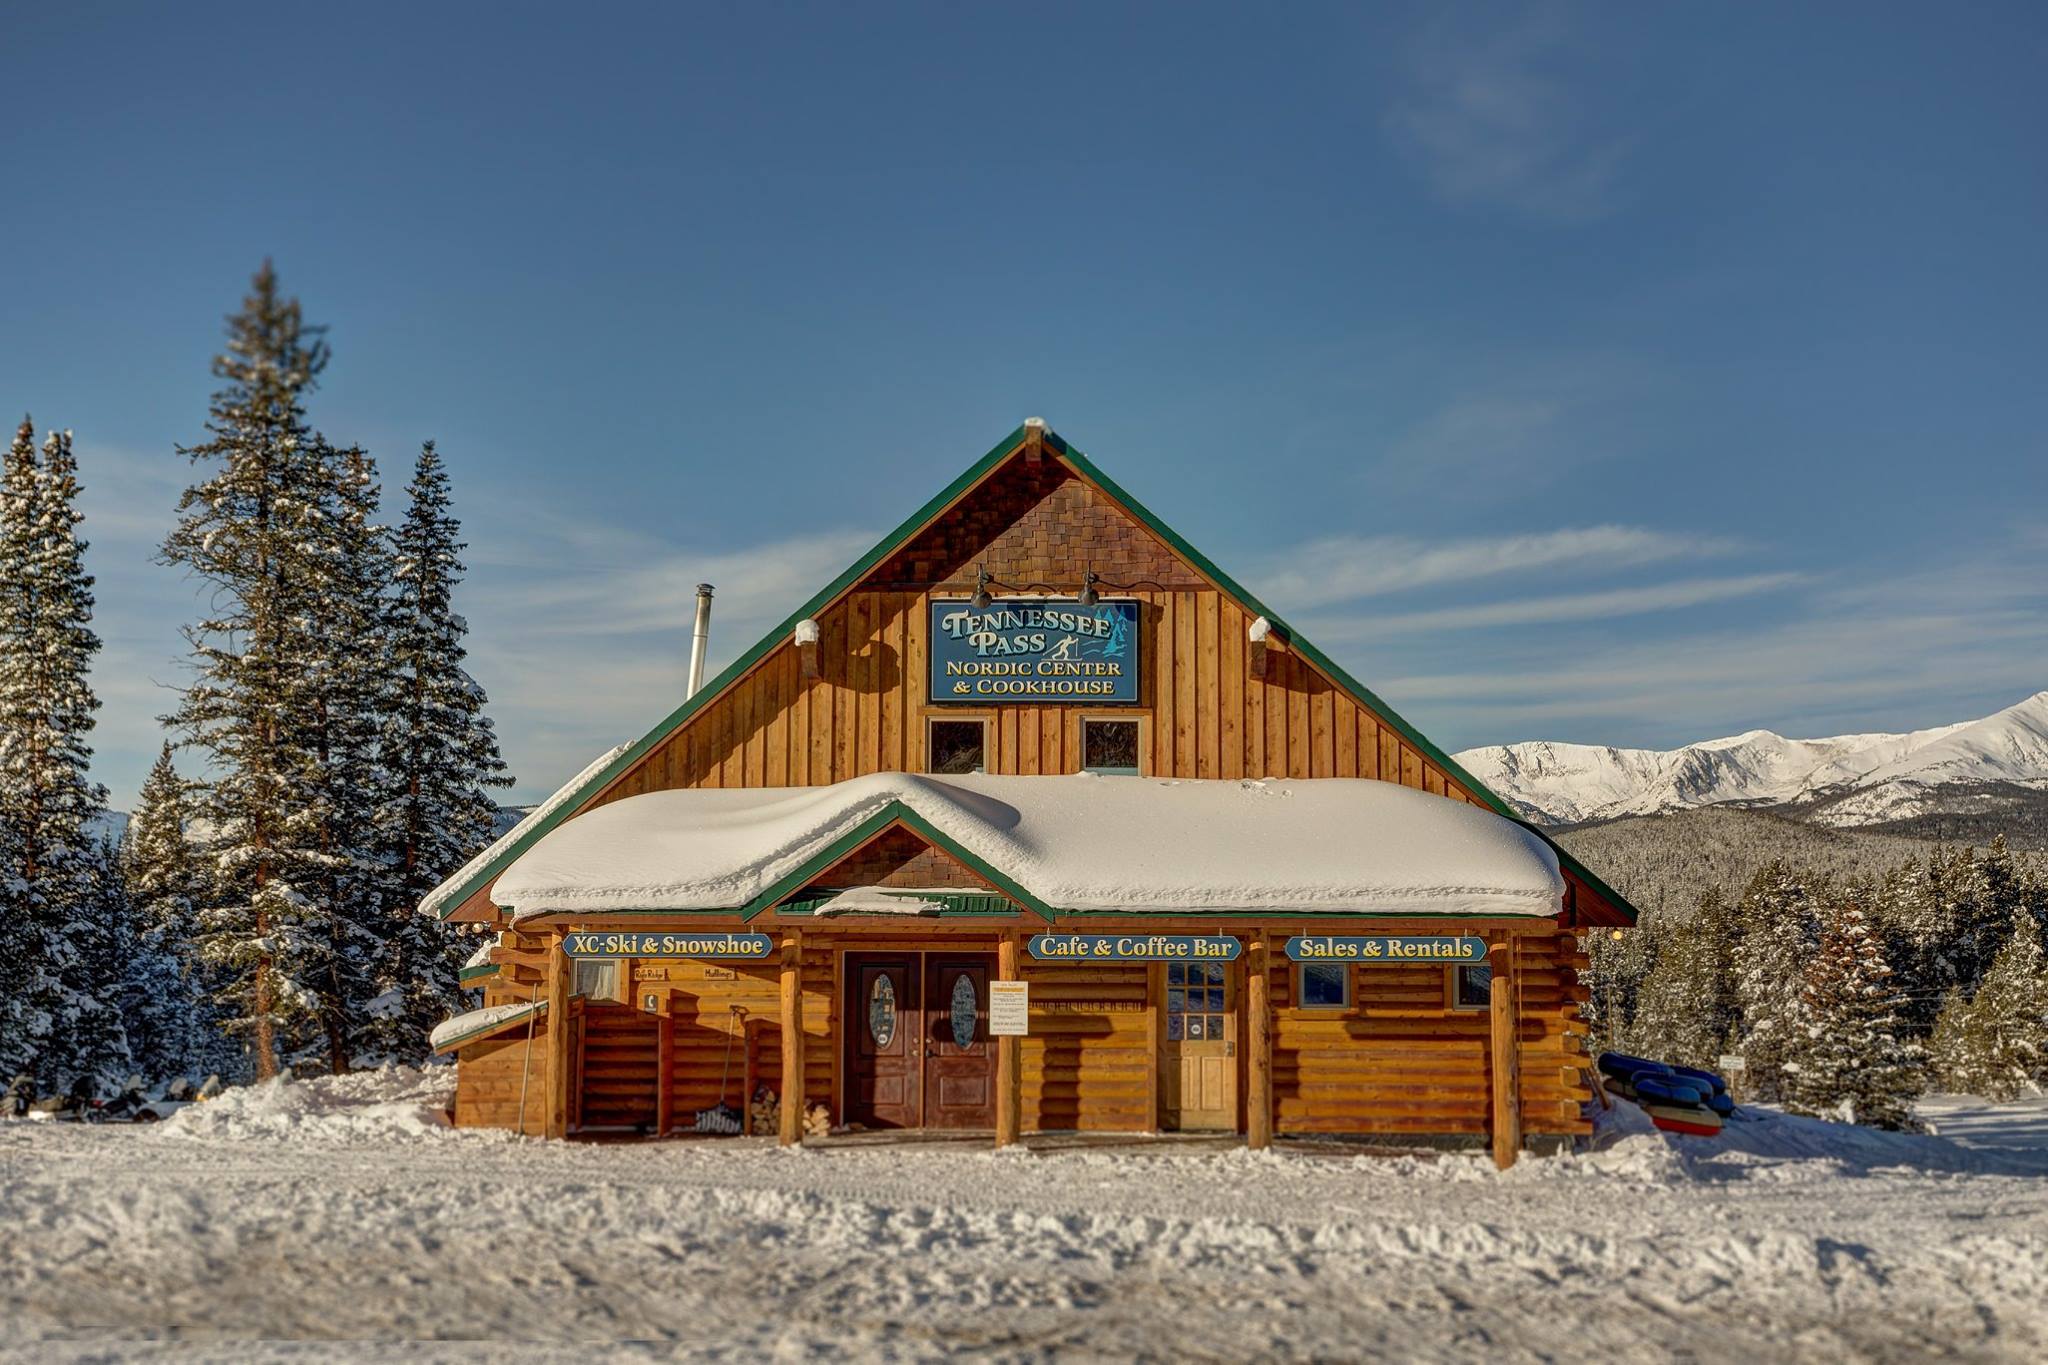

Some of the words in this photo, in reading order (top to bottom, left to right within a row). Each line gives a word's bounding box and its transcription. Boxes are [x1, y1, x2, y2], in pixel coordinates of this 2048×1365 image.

[941, 609, 1111, 638] TENNESSEE
[969, 632, 1045, 657] PASS
[946, 661, 1033, 676] NORDIC
[1037, 661, 1122, 676] CENTER
[953, 681, 971, 694] &
[977, 680, 1115, 694] COOKHOUSE
[573, 935, 637, 954] XC-Ski
[642, 937, 659, 954] &
[663, 935, 763, 954] Snowshoe
[1040, 937, 1089, 956] Cafe
[1094, 939, 1112, 956] &
[1117, 936, 1192, 956] Coffee
[1193, 939, 1233, 956] Bar
[1300, 938, 1357, 957] Sales
[1363, 940, 1382, 957] &
[1387, 938, 1473, 958] Rentals
